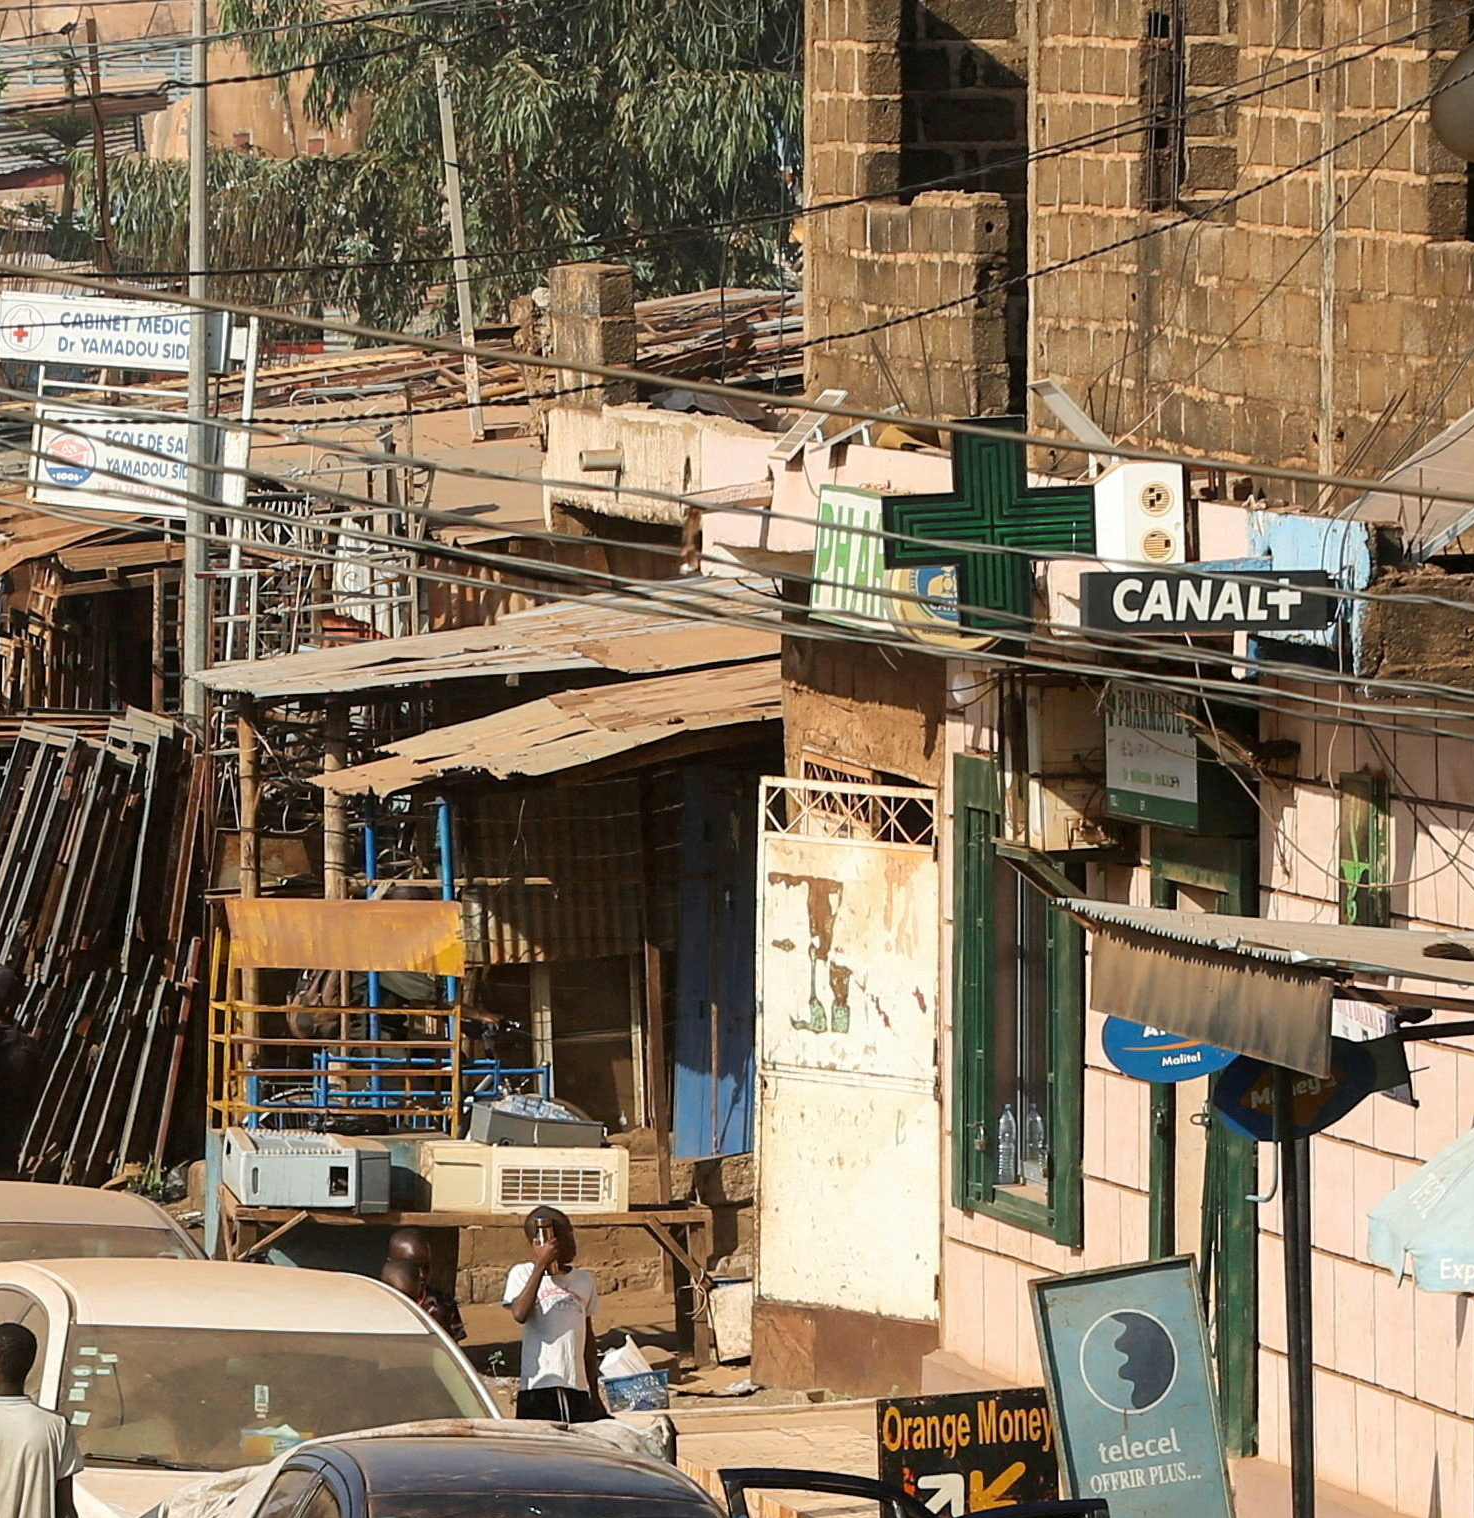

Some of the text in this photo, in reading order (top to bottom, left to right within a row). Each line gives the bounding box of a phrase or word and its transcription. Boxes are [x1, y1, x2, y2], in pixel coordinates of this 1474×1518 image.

[60, 312, 130, 333] CABINET
[58, 336, 75, 352] Dr
[80, 338, 159, 358] YAMADOU
[105, 429, 144, 448] ECOLE
[146, 433, 164, 453] DE
[106, 457, 168, 478] YAMADOU
[1112, 578, 1302, 622] CANAL+
[1161, 1051, 1202, 1067] Malitel
[882, 1400, 1055, 1459] Orange Money
[1097, 1428, 1181, 1464] telecel
[1089, 1464, 1146, 1495] OFFRIR
